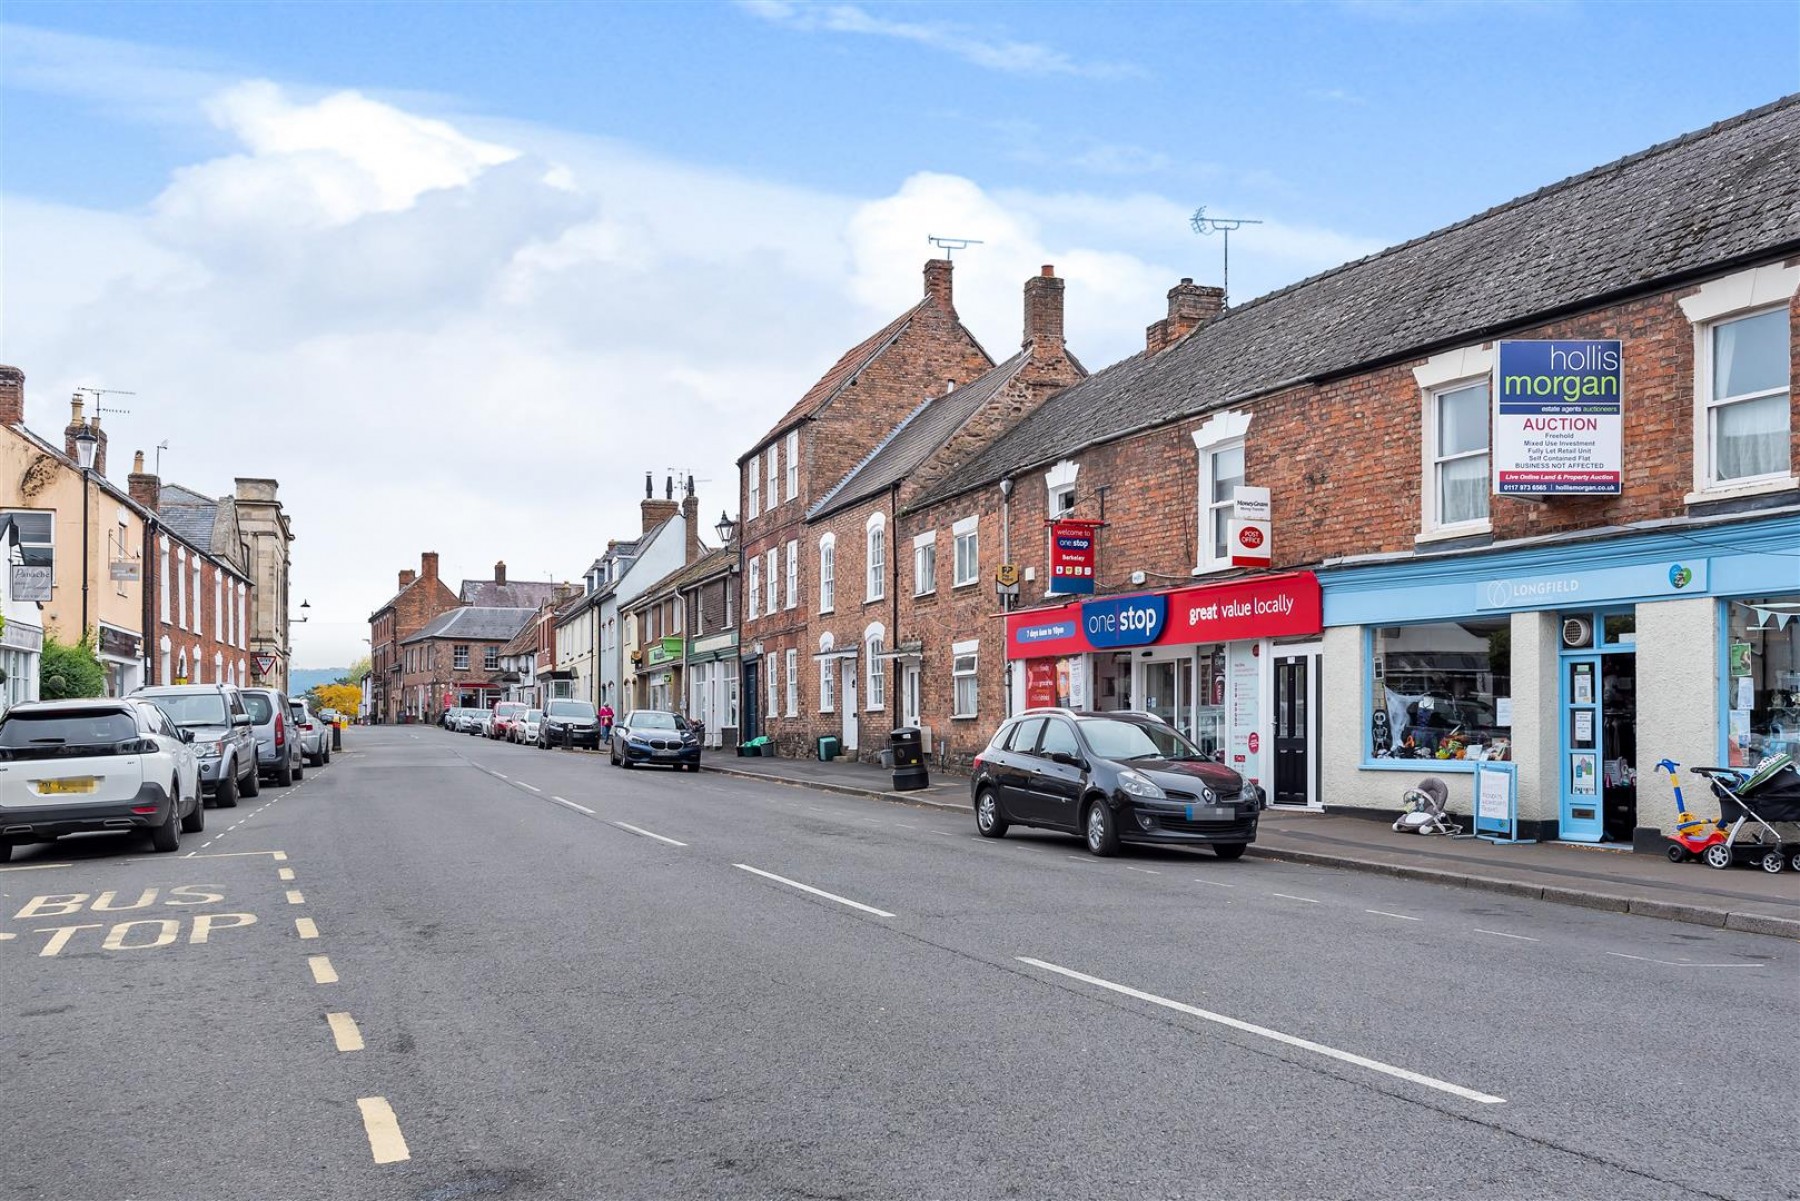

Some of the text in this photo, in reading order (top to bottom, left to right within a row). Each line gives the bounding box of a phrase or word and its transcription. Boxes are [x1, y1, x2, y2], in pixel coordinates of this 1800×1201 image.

[1551, 345, 1618, 370] hollis
[1505, 375, 1617, 402] morgan
[1523, 418, 1597, 431] AUCTION
[1555, 484, 1615, 492] hollismorgan.co.uk
[1073, 539, 1089, 549] stop
[1241, 536, 1260, 544] OFFICE
[1062, 554, 1085, 562] Berkeley
[1513, 579, 1579, 597] LONGFIELD
[1189, 594, 1294, 626] great value locally
[1088, 606, 1157, 636] one stop
[13, 884, 226, 919] BUS
[0, 913, 258, 957] TOP
